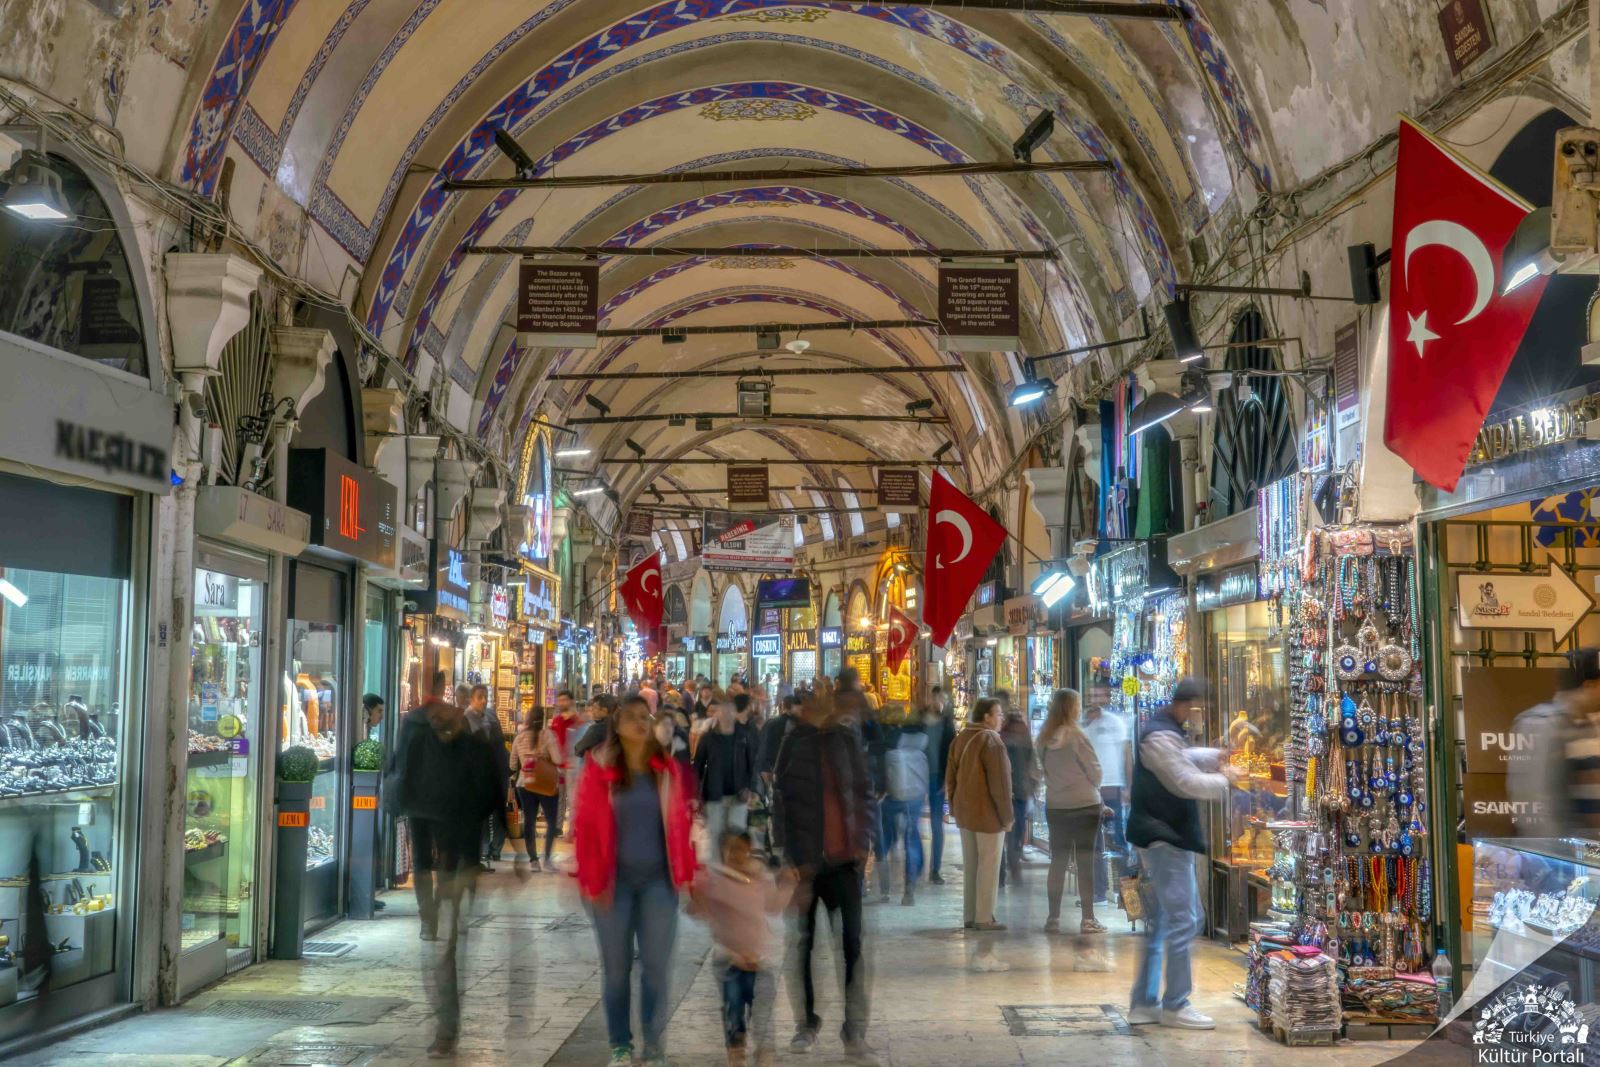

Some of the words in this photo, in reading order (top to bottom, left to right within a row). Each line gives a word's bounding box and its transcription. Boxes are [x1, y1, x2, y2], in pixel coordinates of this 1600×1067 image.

[204, 572, 225, 606] Sara
[790, 632, 809, 650] ALYA
[1473, 801, 1528, 814] SAINT
